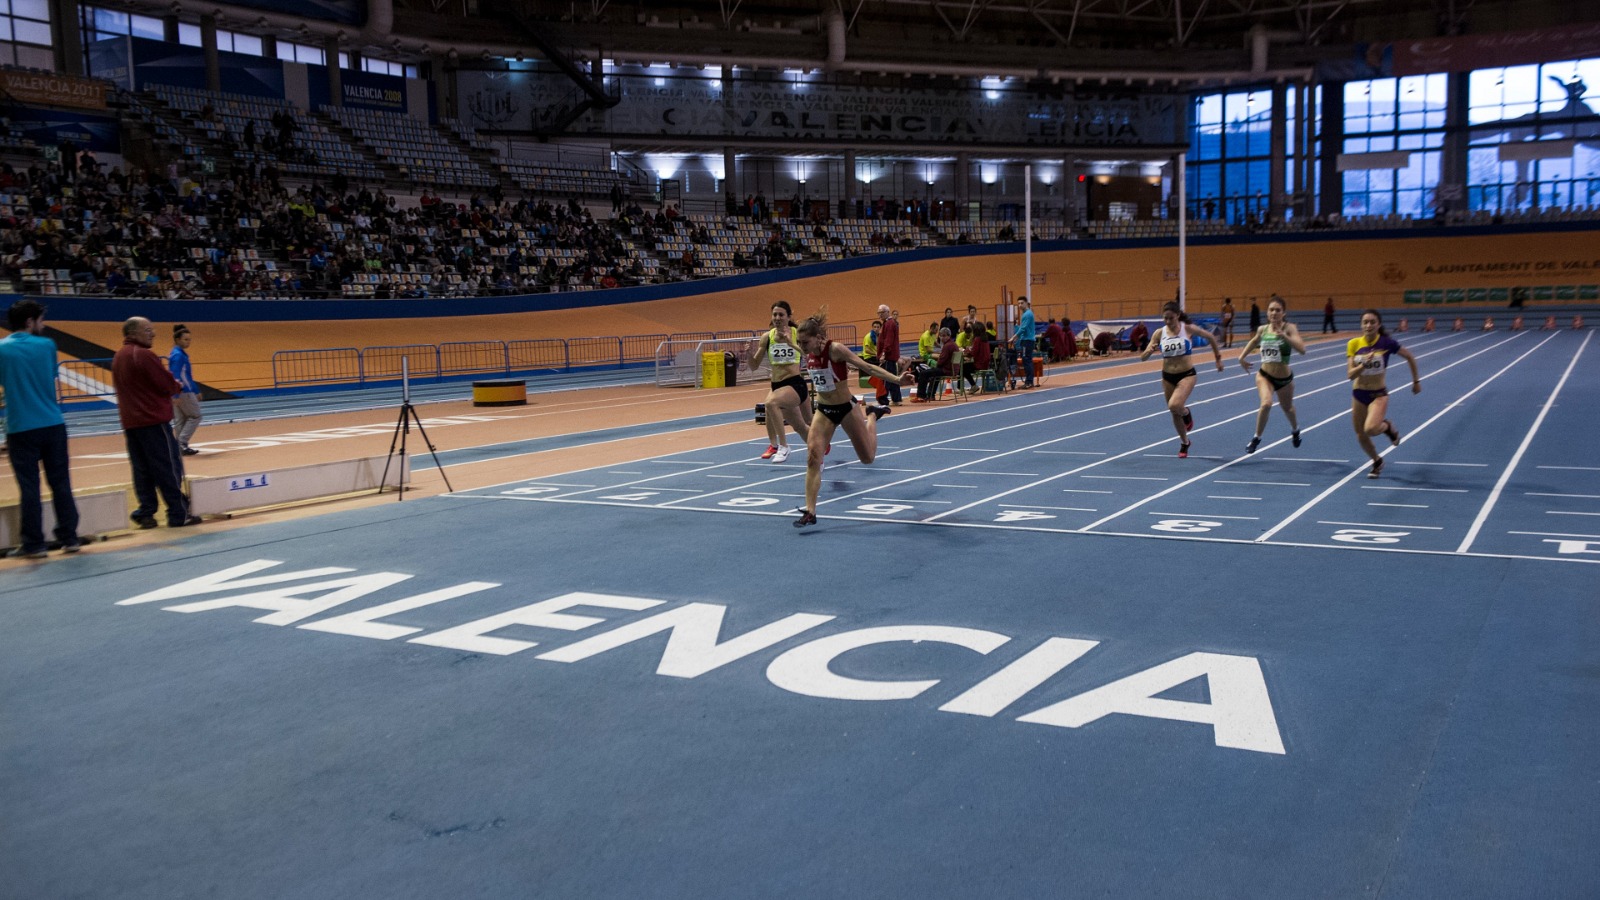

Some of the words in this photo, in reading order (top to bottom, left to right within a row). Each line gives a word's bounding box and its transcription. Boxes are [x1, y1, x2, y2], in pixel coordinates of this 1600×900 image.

[6, 75, 71, 94] VALENCIA
[72, 82, 101, 97] 2011
[344, 84, 383, 100] VALENCIA
[384, 89, 402, 103] 2008
[751, 91, 832, 102] VALENCIA
[839, 95, 906, 105] VALENCIA
[803, 101, 879, 112] VALENCIA
[727, 110, 976, 134] VALENCIA
[1424, 261, 1533, 274] AJUNTAMENT
[1534, 260, 1558, 271] DE
[773, 348, 794, 358] 235
[1164, 342, 1182, 352] 201
[813, 375, 827, 386] 25
[856, 503, 914, 515] 5
[992, 510, 1057, 522] 4
[1150, 519, 1226, 533] 3
[1330, 528, 1412, 544] 2
[114, 557, 1286, 755] VALENCIA
